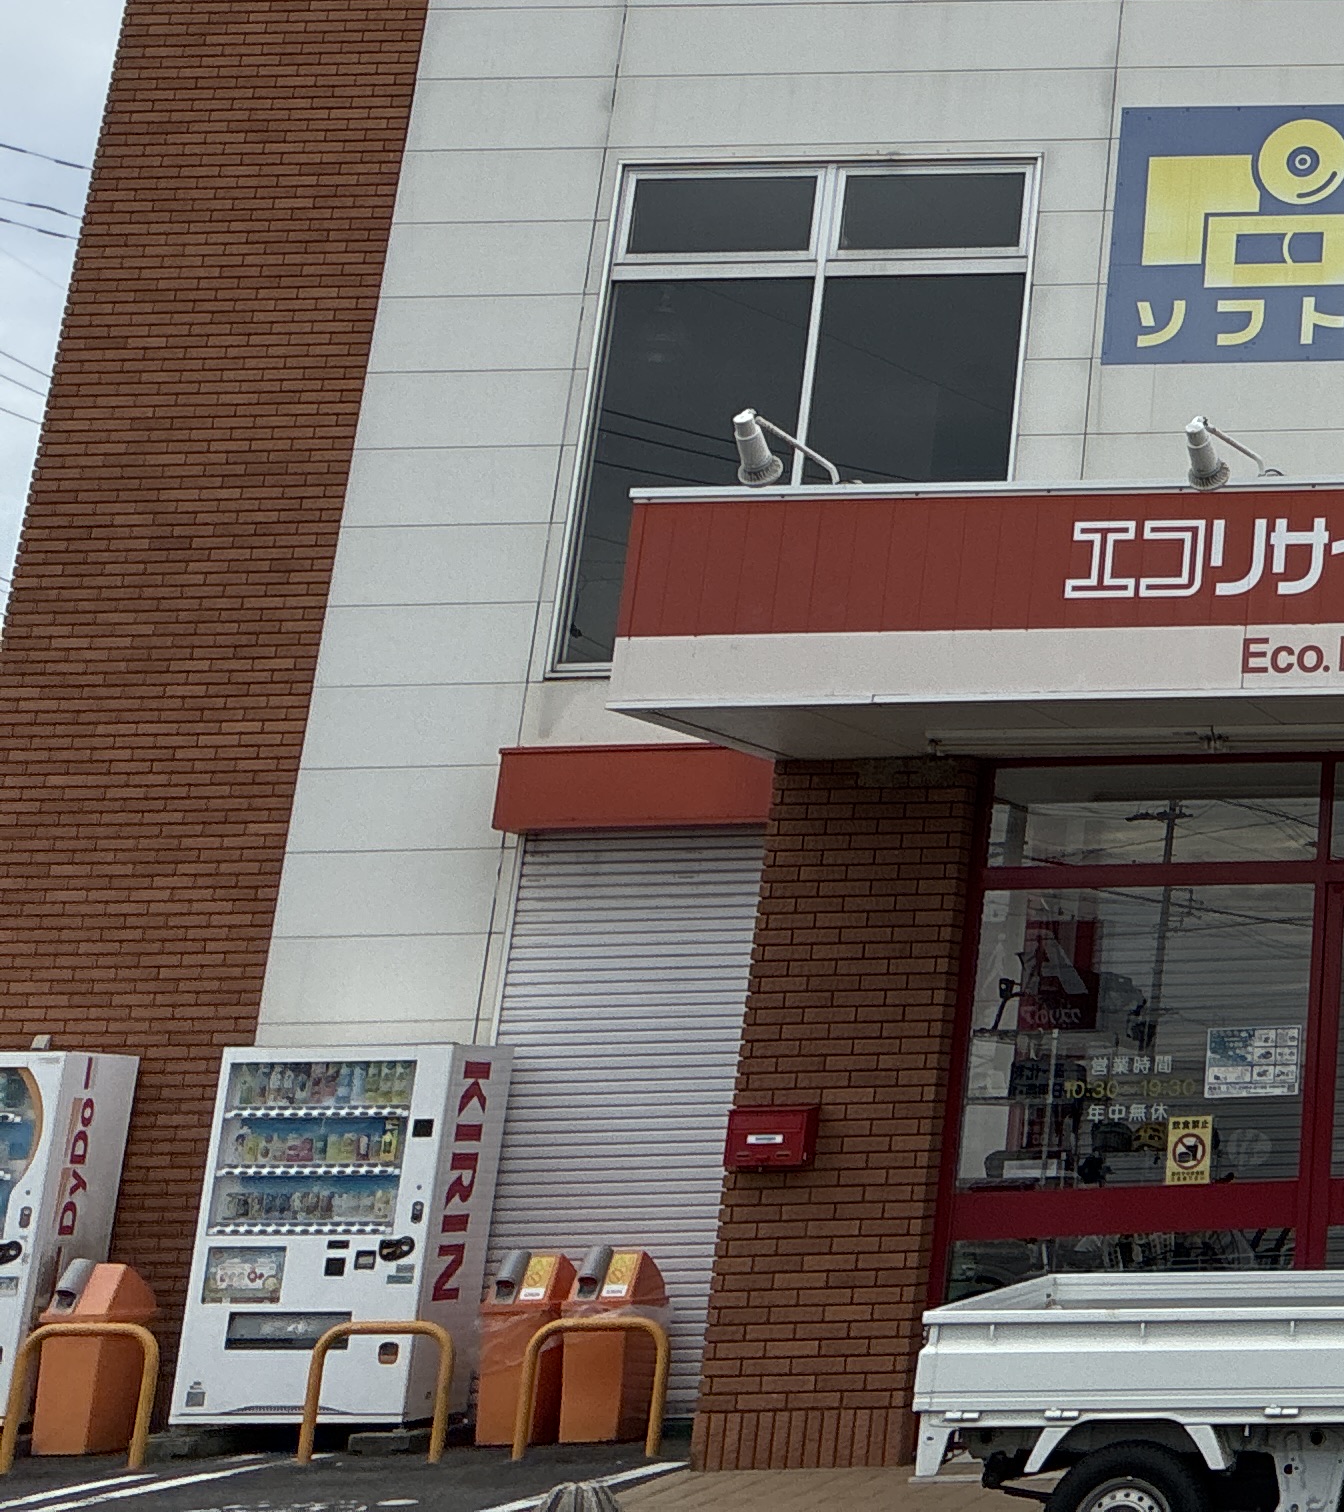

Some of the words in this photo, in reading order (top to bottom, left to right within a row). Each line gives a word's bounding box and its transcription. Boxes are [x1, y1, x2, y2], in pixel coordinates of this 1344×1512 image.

[1137, 299, 1344, 346] ソフト
[1090, 1055, 1173, 1076] 営業時間
[1087, 1102, 1169, 1124] 年中無休
[431, 1060, 493, 1302] KIRIN
